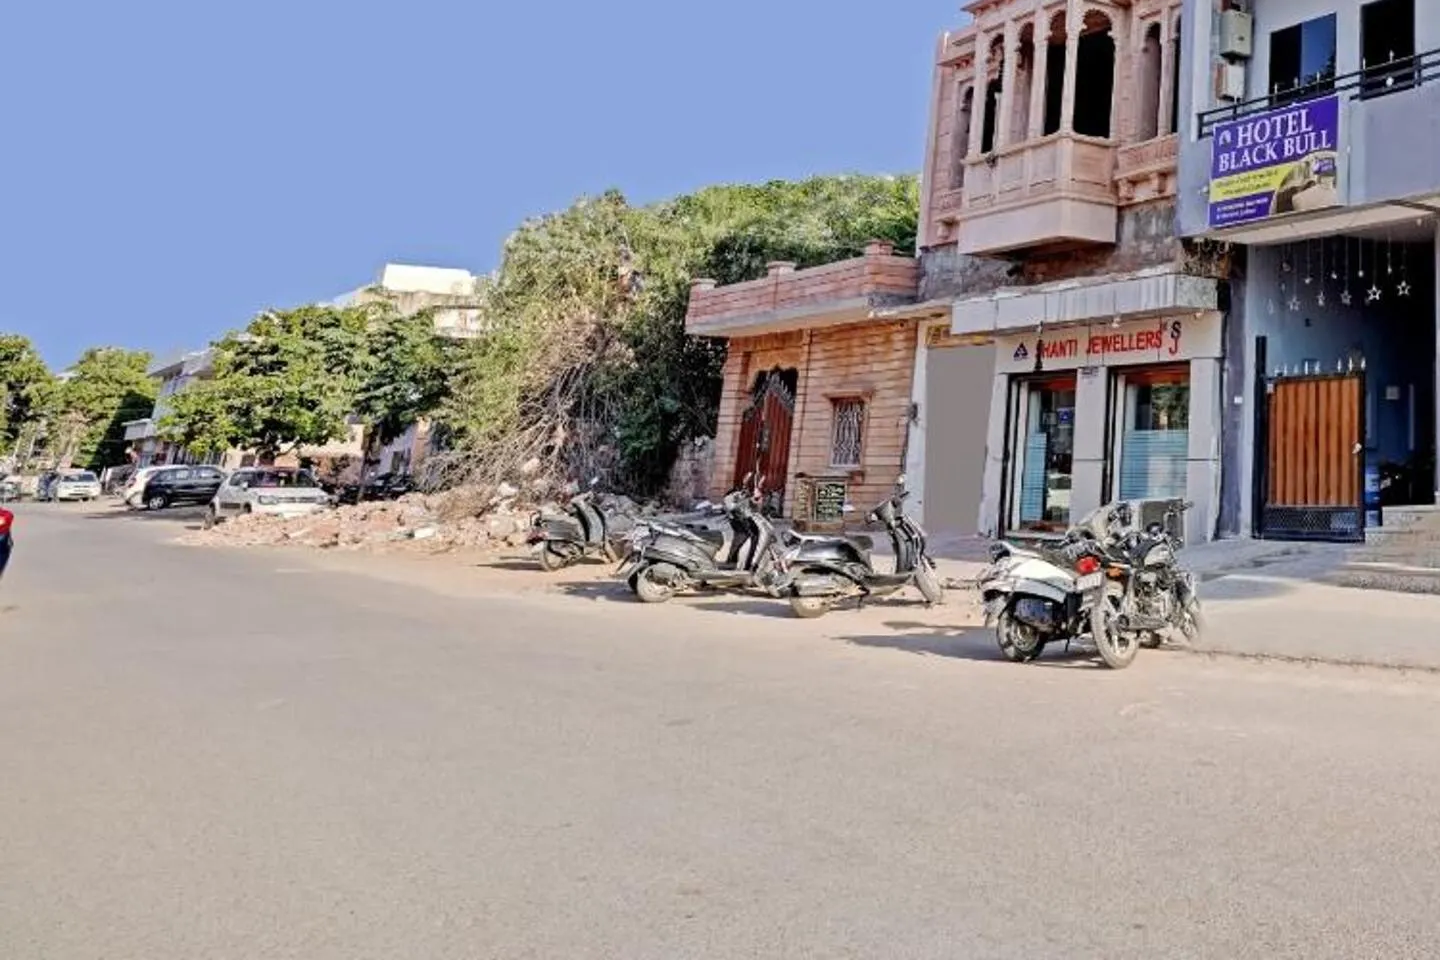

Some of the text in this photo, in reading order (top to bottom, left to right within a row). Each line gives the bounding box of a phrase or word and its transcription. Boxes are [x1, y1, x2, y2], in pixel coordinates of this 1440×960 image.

[1236, 109, 1313, 148] HOTEL
[1218, 130, 1331, 172] BLACK BULL
[1036, 339, 1078, 359] HANTI
